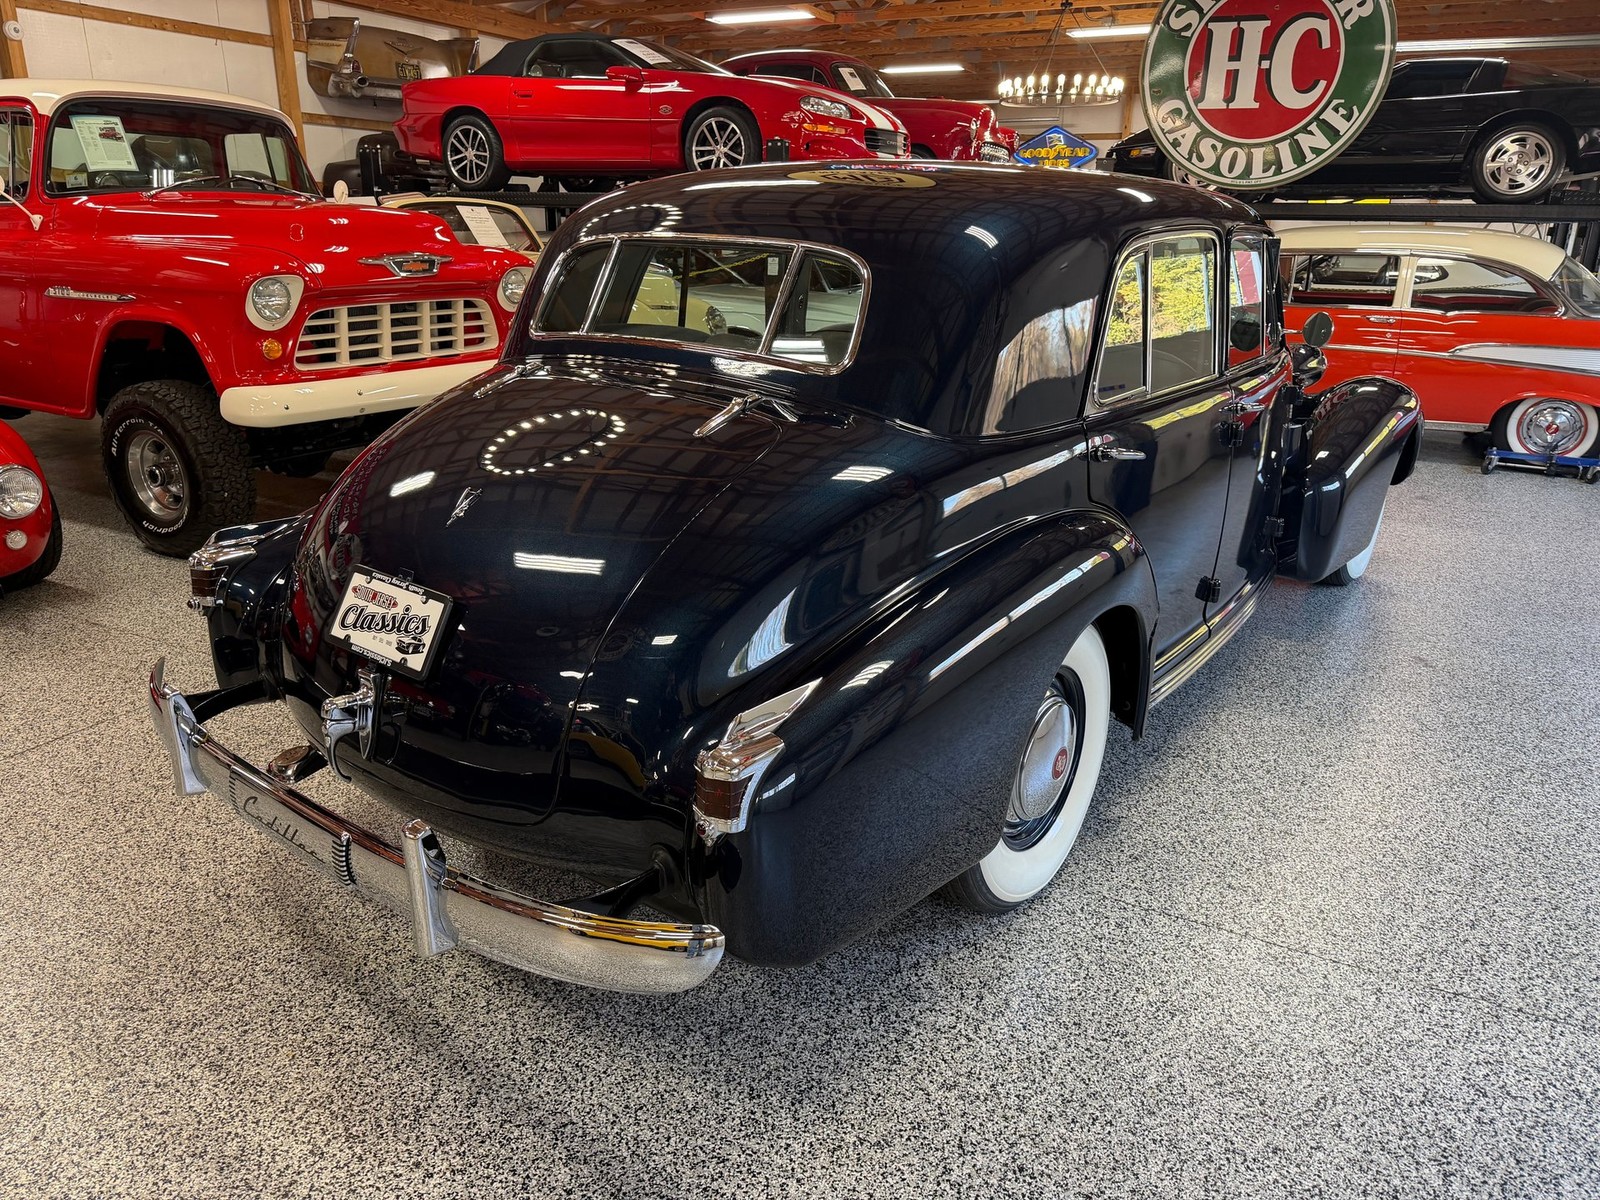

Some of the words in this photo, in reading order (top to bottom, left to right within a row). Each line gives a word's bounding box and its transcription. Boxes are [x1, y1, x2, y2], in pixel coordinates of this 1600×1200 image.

[1196, 17, 1332, 109] H-C
[1156, 98, 1360, 179] GASOLINE
[111, 417, 145, 456] All-Terrain
[372, 571, 391, 584] Classics
[391, 576, 409, 588] Jersey
[408, 585, 425, 596] South
[354, 584, 373, 604] SOUTH
[373, 590, 397, 611] JERSEY
[340, 604, 431, 636] Classics
[351, 643, 393, 667] SJClassics.com
[243, 796, 325, 864] Cadillac
